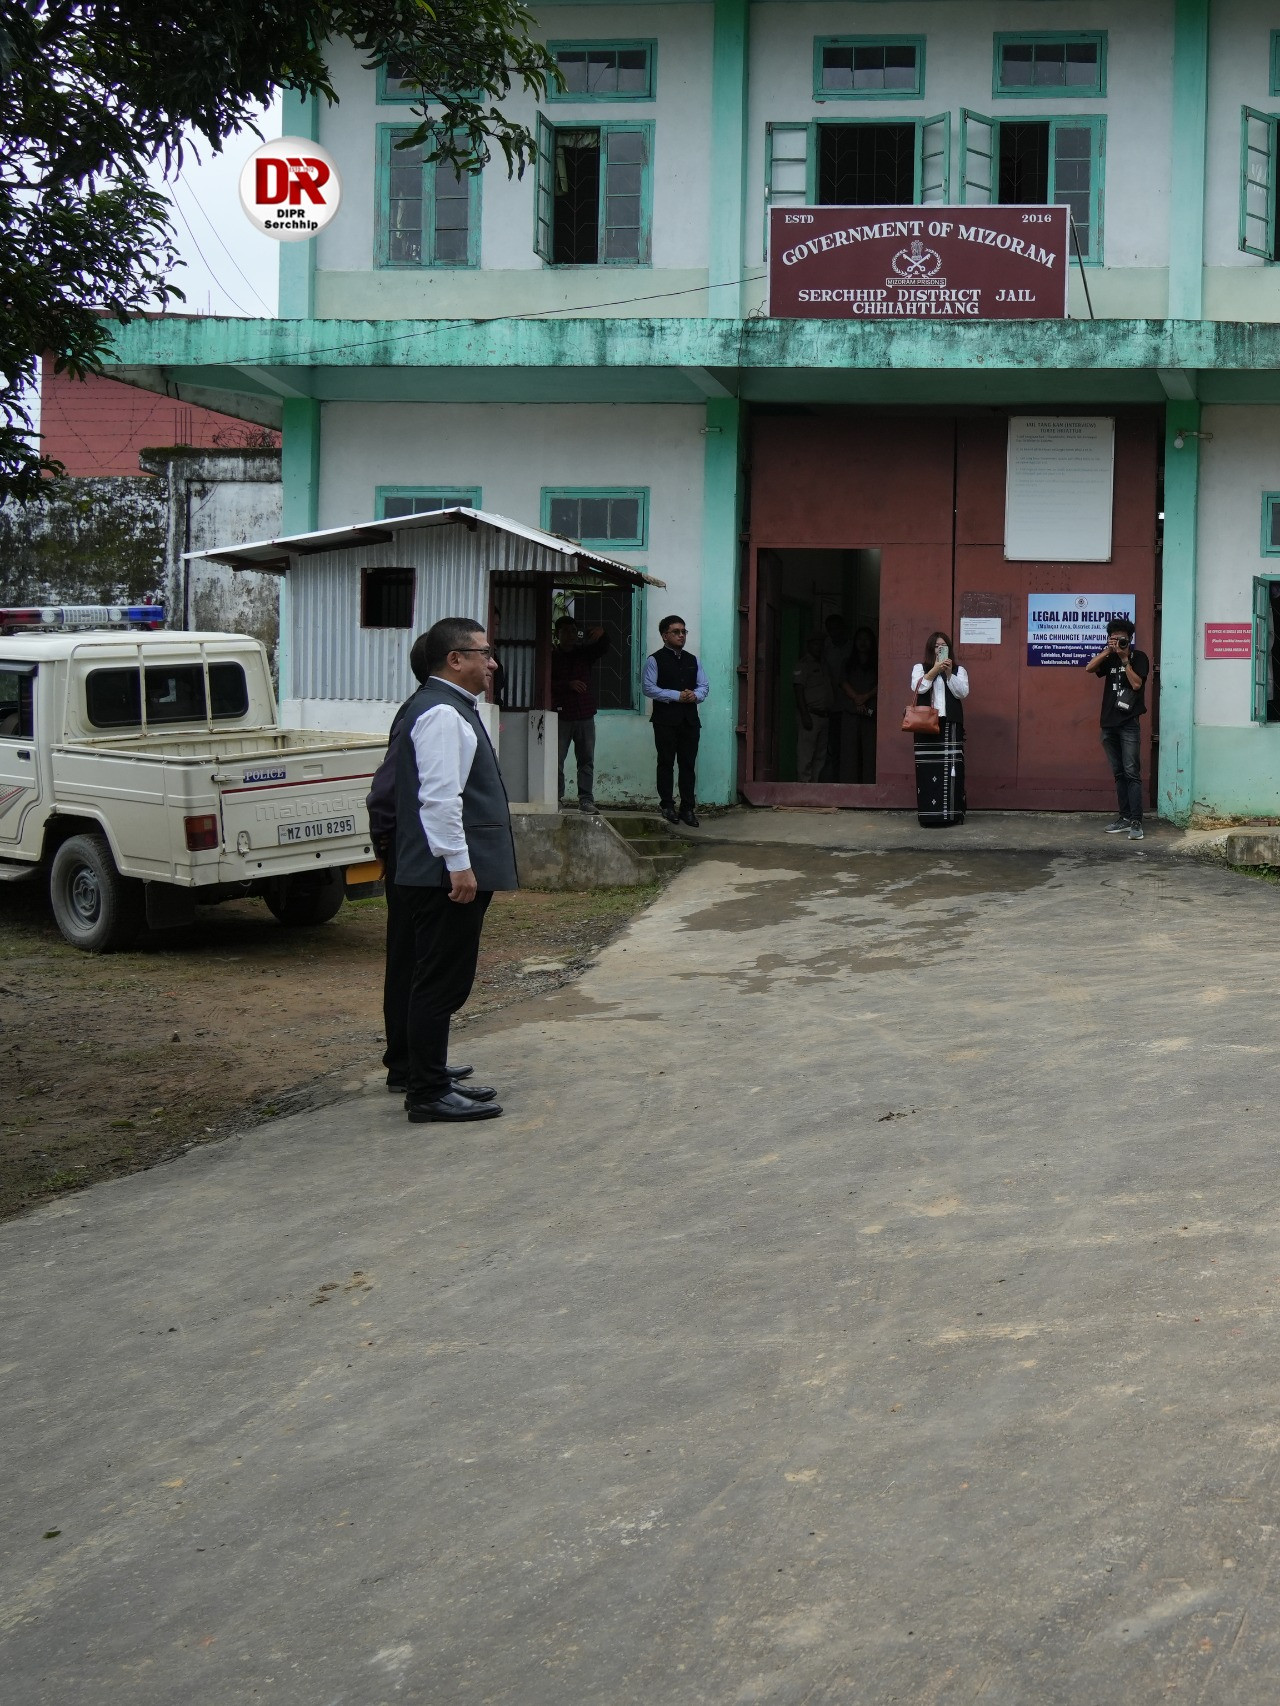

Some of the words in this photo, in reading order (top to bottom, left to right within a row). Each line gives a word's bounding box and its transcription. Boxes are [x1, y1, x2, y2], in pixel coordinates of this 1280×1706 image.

[785, 214, 814, 224] ESTD
[1021, 214, 1052, 223] 2016
[782, 221, 924, 266] GOVERNMENT
[928, 221, 953, 237] OF
[958, 225, 1056, 268] MIZORAM
[798, 289, 888, 302] SERCHHIP
[898, 289, 981, 302] DISTRICT
[996, 289, 1036, 302] JAIL
[852, 301, 979, 315] CHHIAHTLANG
[1032, 611, 1060, 622] LEGAL
[1062, 611, 1079, 622] AID
[1081, 611, 1130, 623] HELPDESK
[1049, 633, 1080, 641] CHHUNGTE
[246, 768, 284, 781] POLICE
[287, 827, 301, 840] MZ
[305, 823, 323, 838] 01U
[327, 819, 352, 834] 8295
